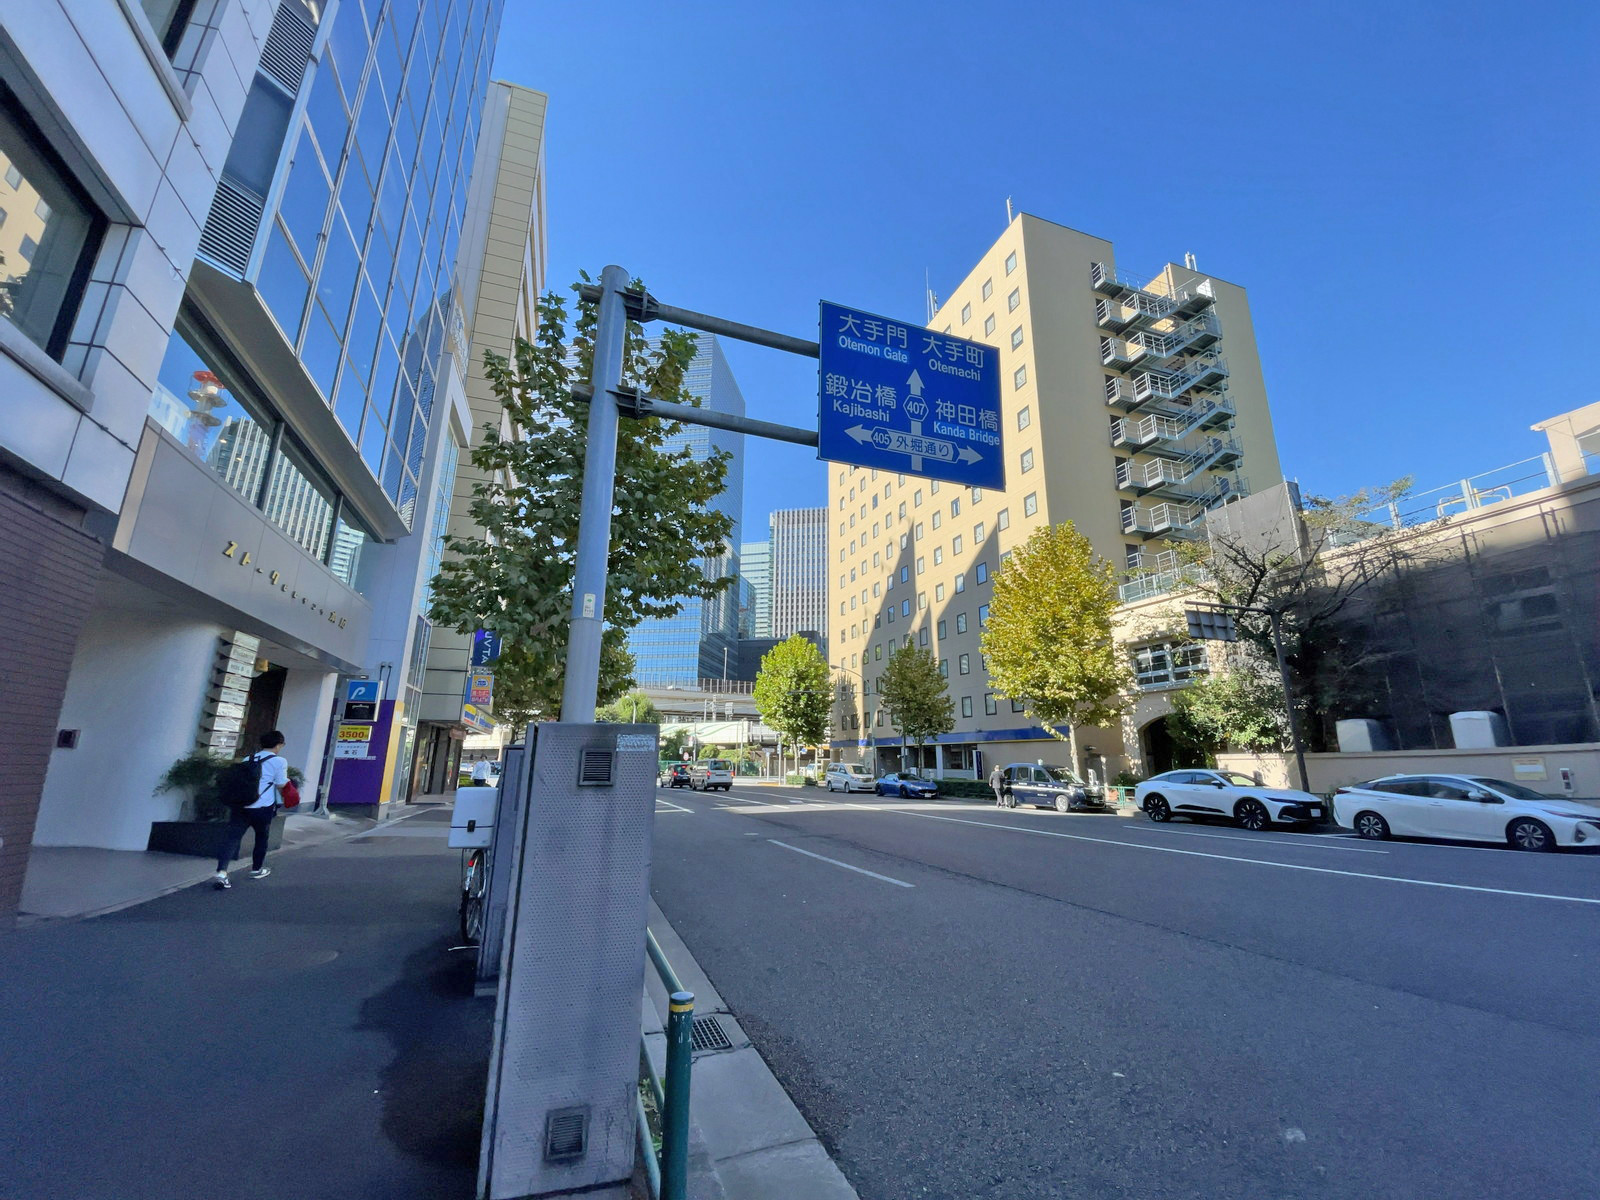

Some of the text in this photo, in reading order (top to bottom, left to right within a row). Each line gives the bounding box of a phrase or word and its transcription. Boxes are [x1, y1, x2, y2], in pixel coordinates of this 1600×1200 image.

[839, 314, 908, 349] 大手門
[839, 335, 908, 363] Otemon Gate
[922, 336, 984, 368] 大手町
[929, 358, 981, 381] Otemachi
[825, 373, 897, 409] 鍛冶橋
[833, 400, 890, 422] Kajibashi
[906, 401, 924, 415] 407
[936, 398, 998, 432] 神田橋
[873, 432, 890, 445] 405
[934, 421, 1000, 446] Kanda Bridge
[896, 436, 950, 457] 外堀通り
